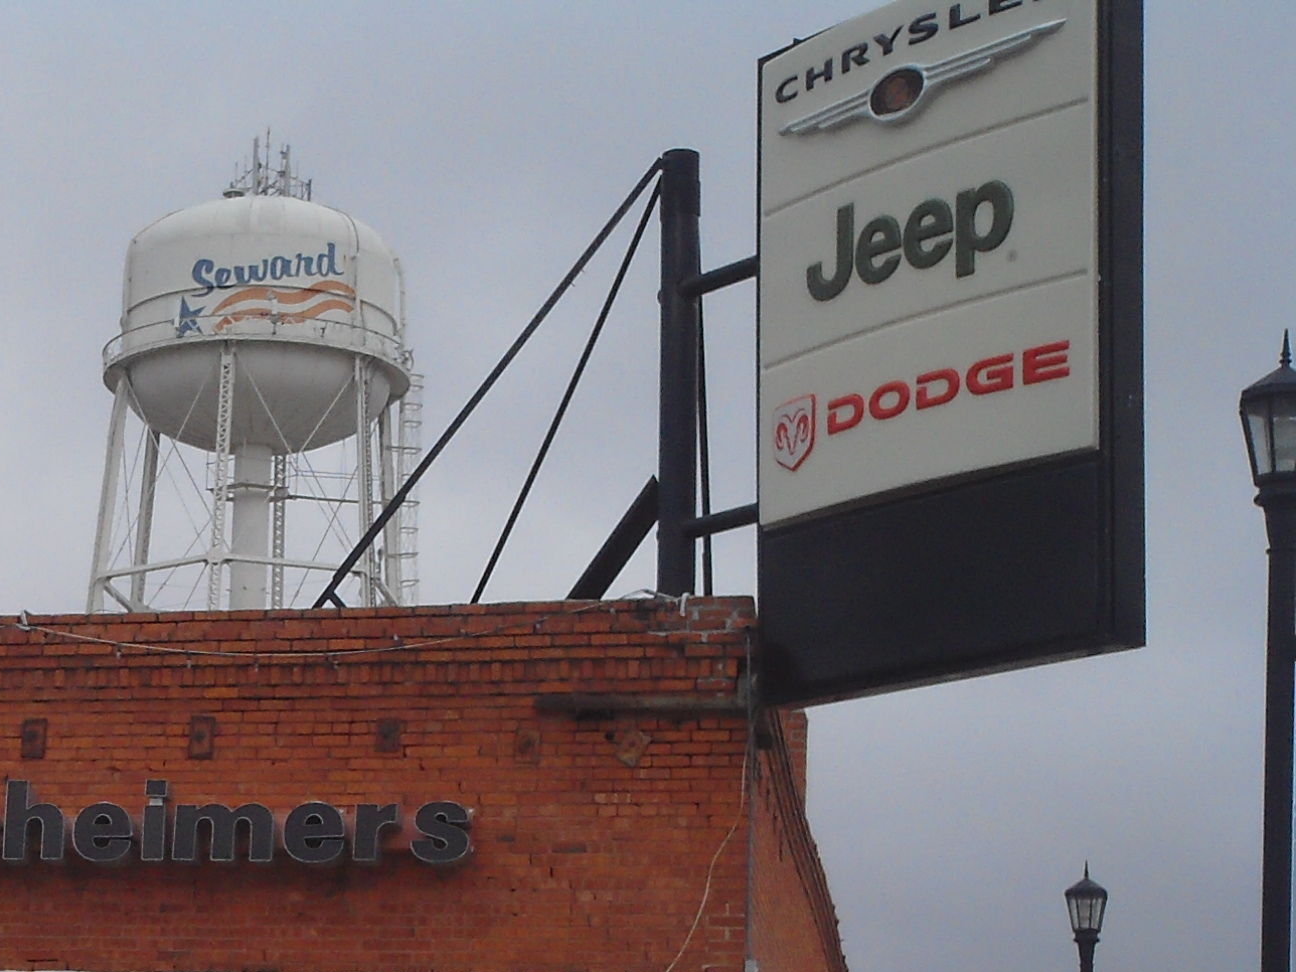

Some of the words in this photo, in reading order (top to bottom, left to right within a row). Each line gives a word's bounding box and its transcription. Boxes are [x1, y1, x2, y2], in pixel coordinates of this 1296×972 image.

[775, 0, 1041, 103] CHRYSLE
[191, 242, 344, 297] Seward
[806, 179, 1014, 302] Jeep
[827, 340, 1070, 435] DODGE
